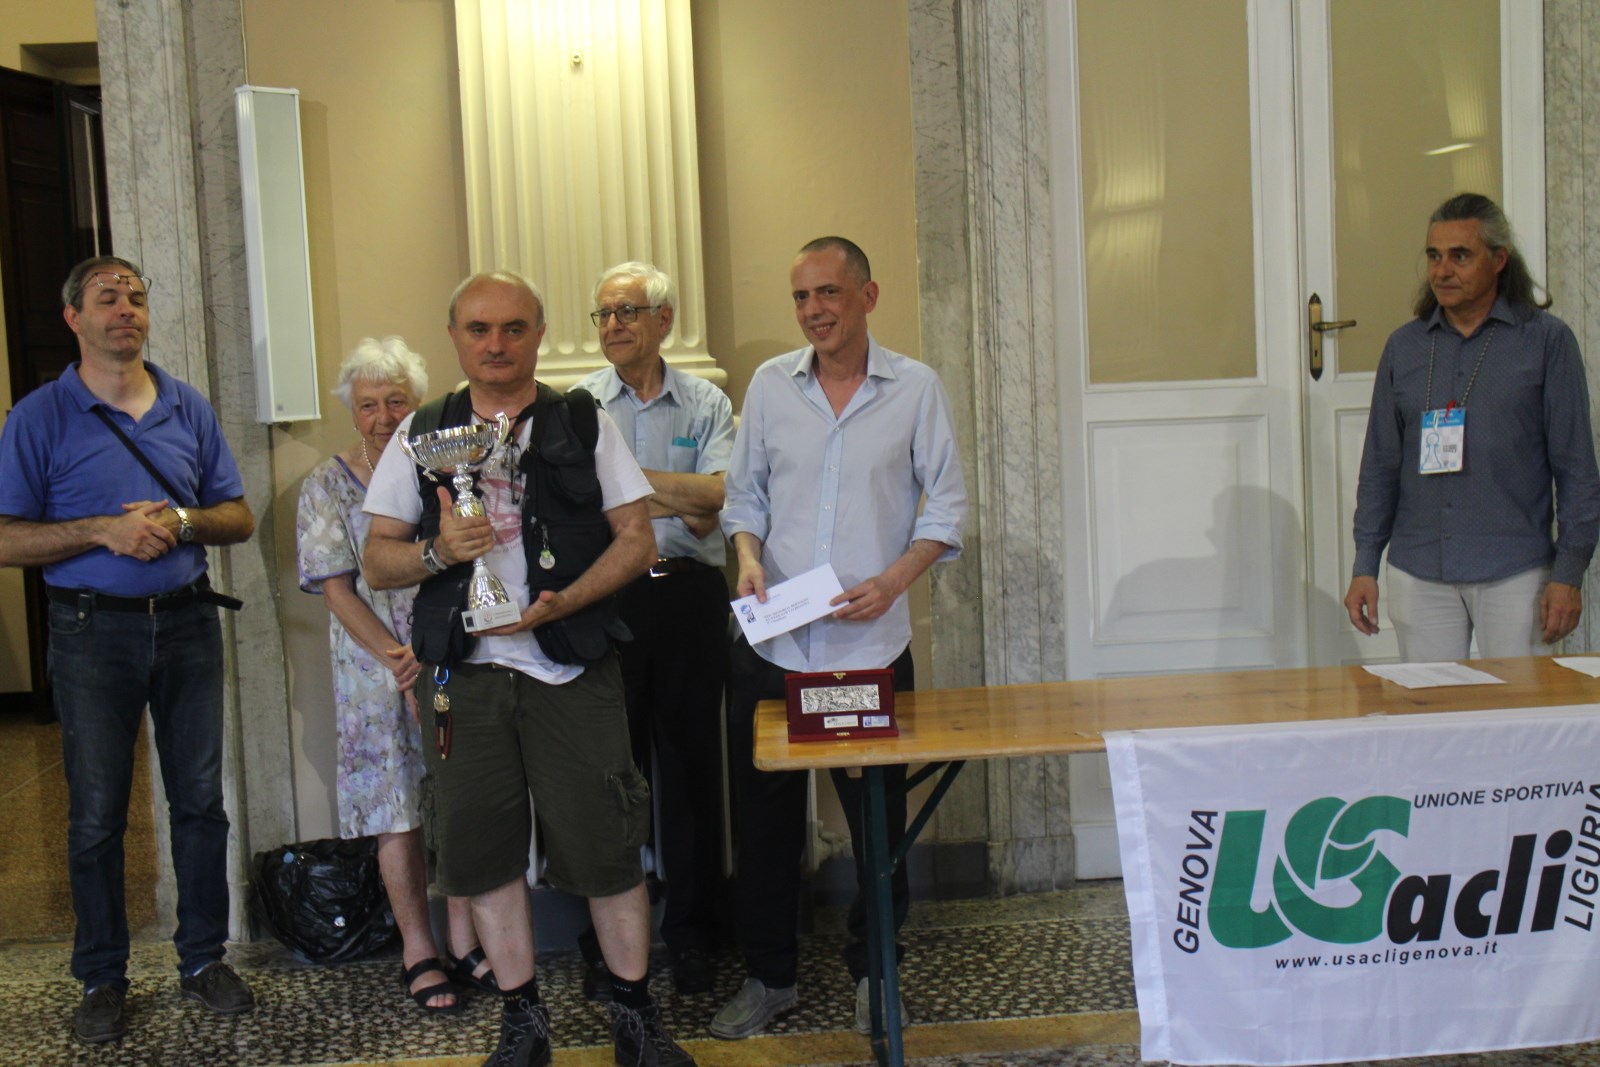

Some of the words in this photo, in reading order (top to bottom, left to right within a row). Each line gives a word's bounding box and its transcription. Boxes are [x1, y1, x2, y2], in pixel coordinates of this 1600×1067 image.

[1414, 790, 1486, 808] UNIONE
[1491, 780, 1585, 803] SPORTIVA
[1173, 810, 1219, 954] GENOVA
[1275, 941, 1499, 969] www.usacligenova.it
